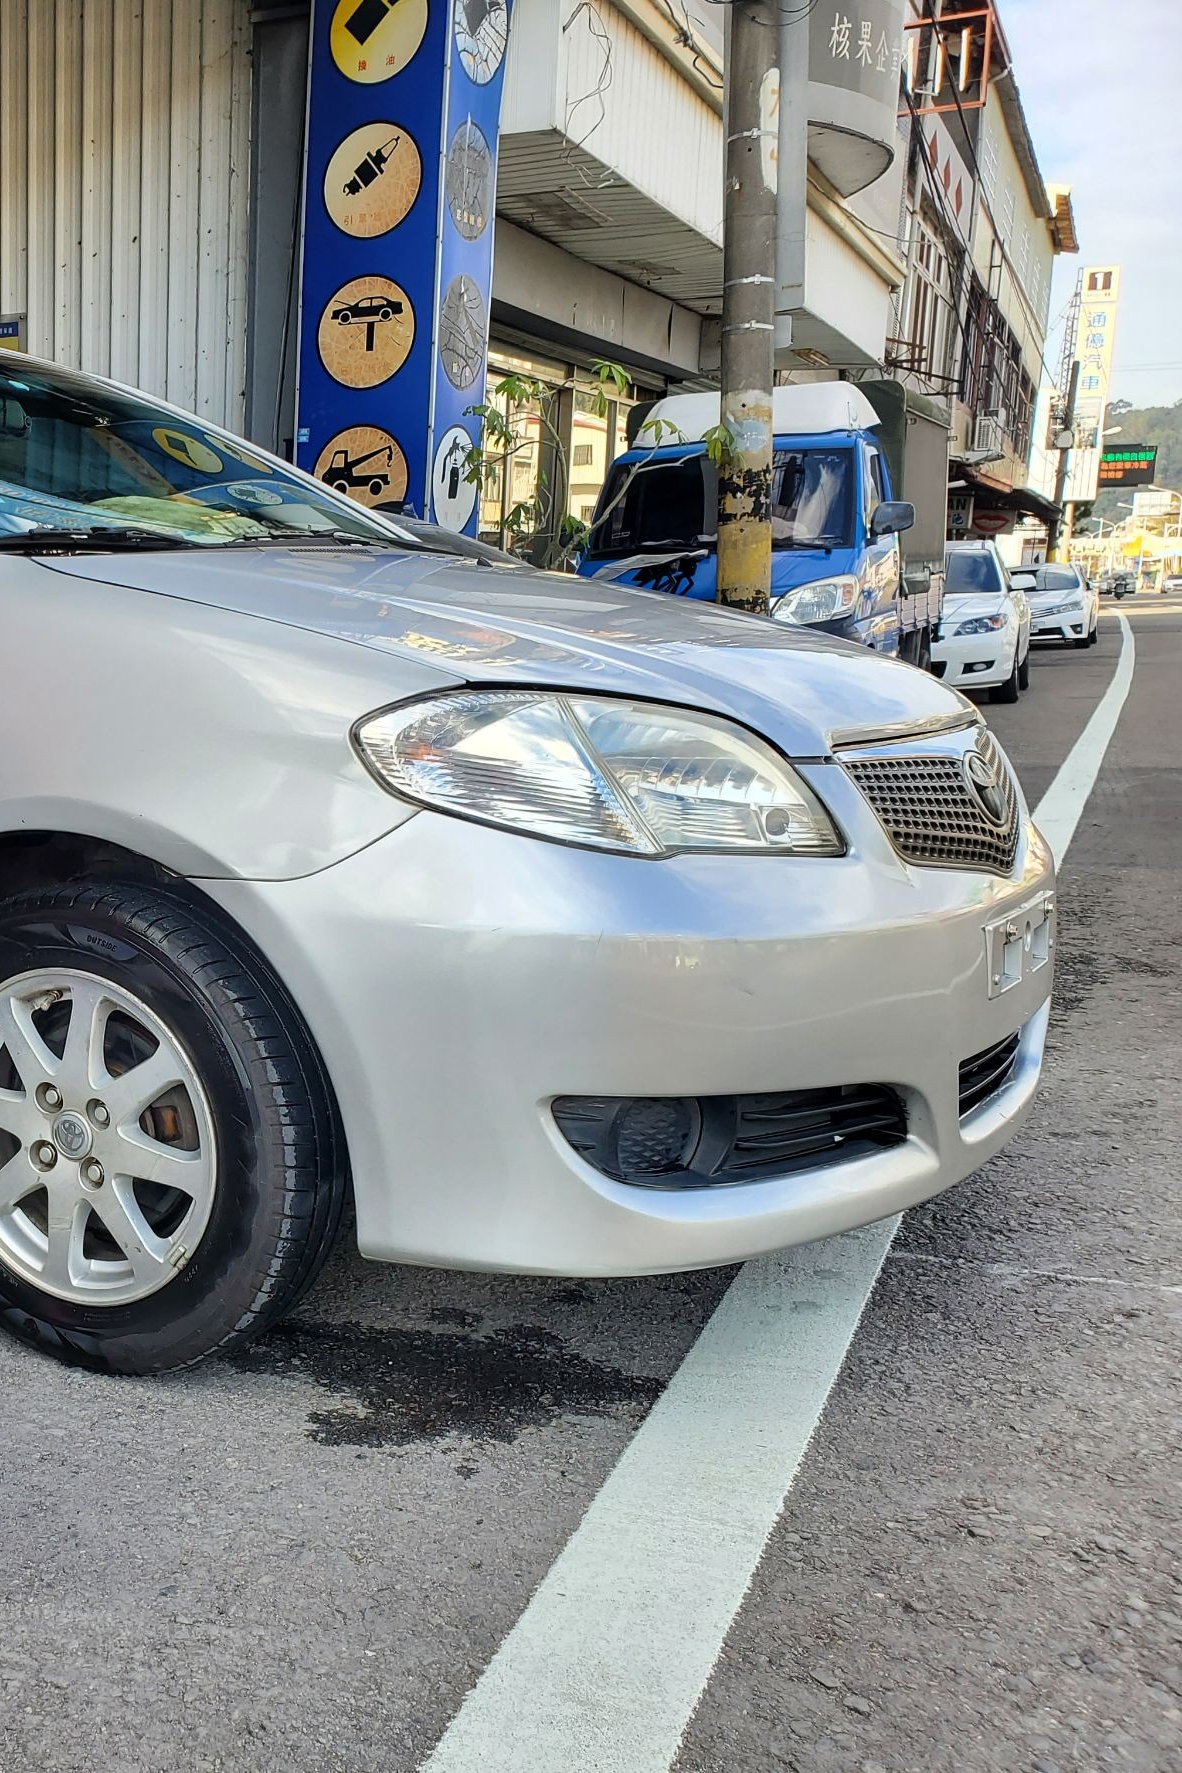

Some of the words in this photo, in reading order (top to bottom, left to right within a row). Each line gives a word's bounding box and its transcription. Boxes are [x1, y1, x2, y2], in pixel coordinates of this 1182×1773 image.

[358, 54, 396, 71] 換油
[1081, 311, 1106, 390] 通億汽車
[86, 934, 118, 953] OUTSIDE
